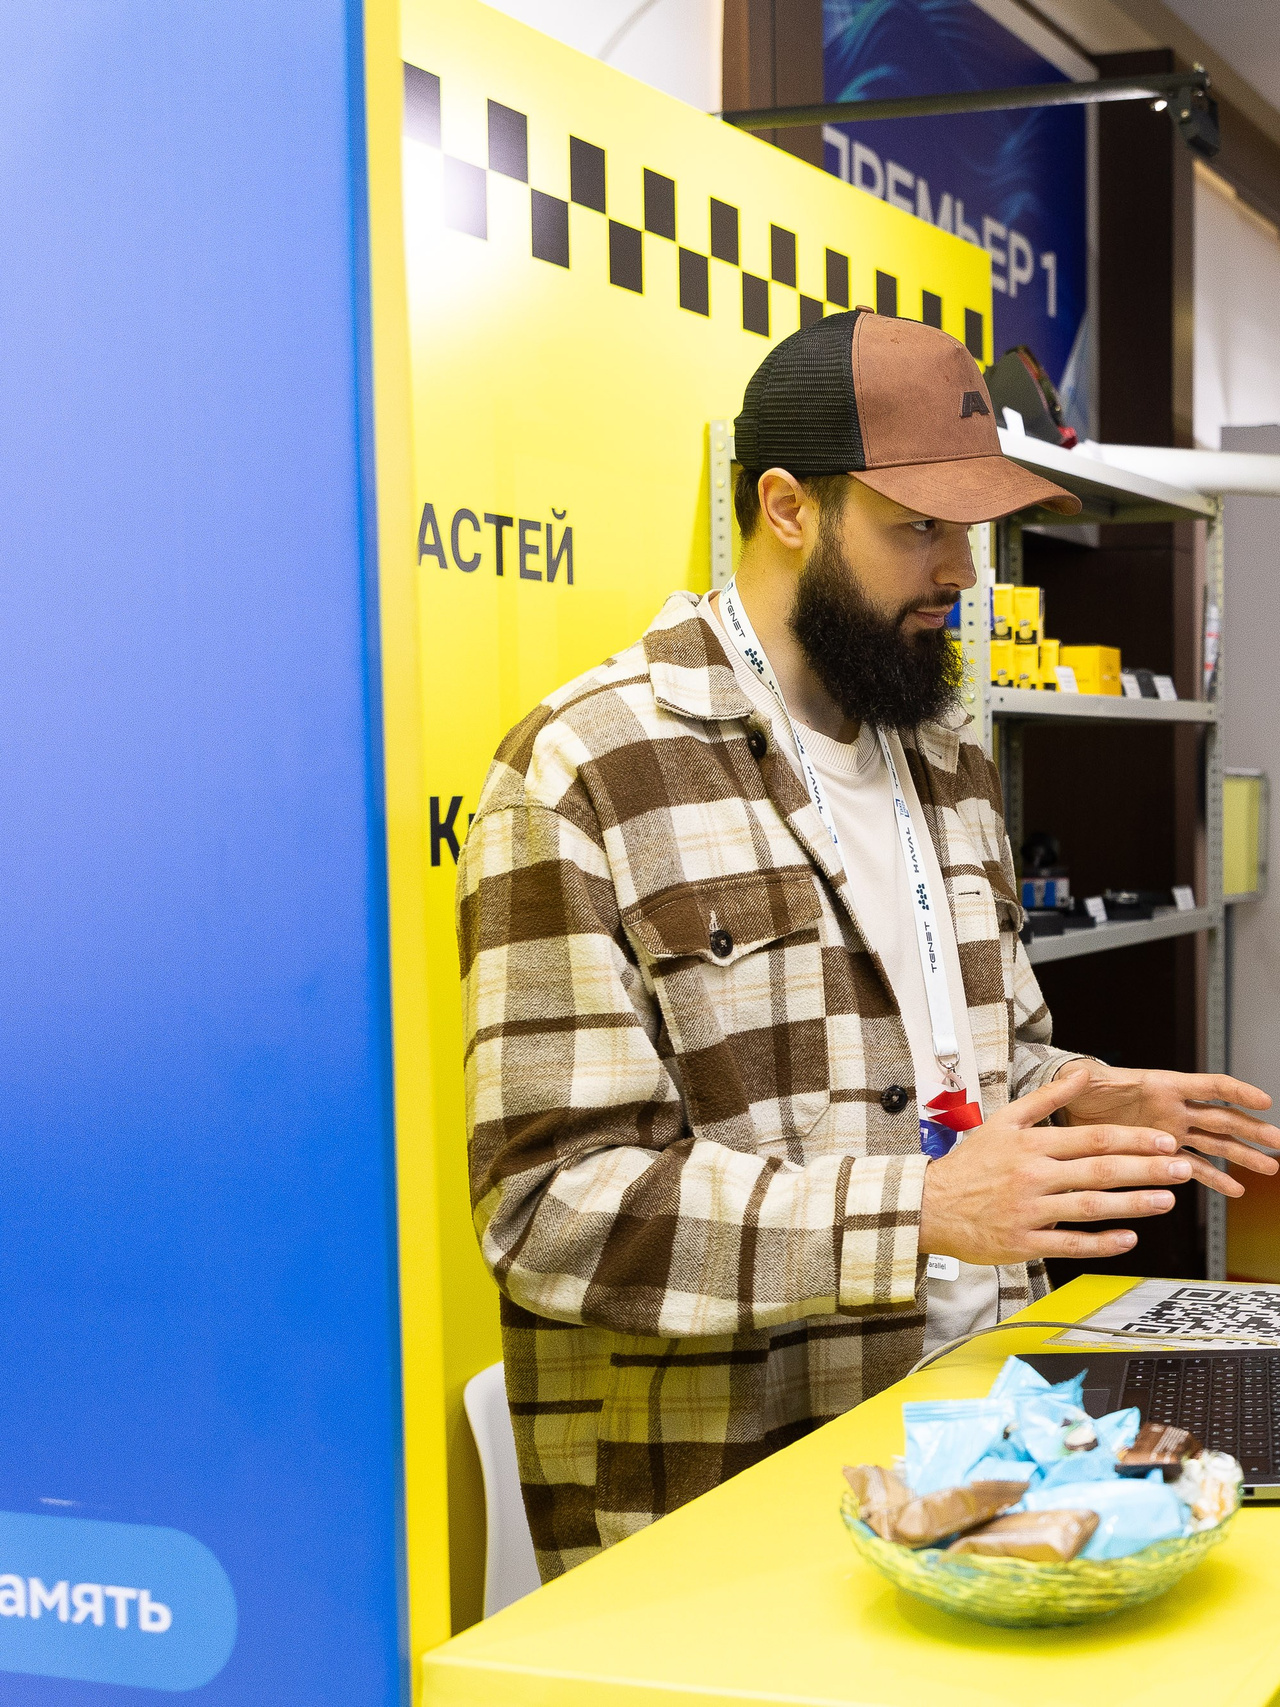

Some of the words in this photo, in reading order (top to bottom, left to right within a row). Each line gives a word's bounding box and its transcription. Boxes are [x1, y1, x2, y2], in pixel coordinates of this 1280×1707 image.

[417, 502, 574, 585] АСТЕЙ
[806, 765, 824, 815] HAVAL
[429, 795, 477, 867] К
[905, 826, 920, 874] HAVAL
[0, 1574, 173, 1633] амять
